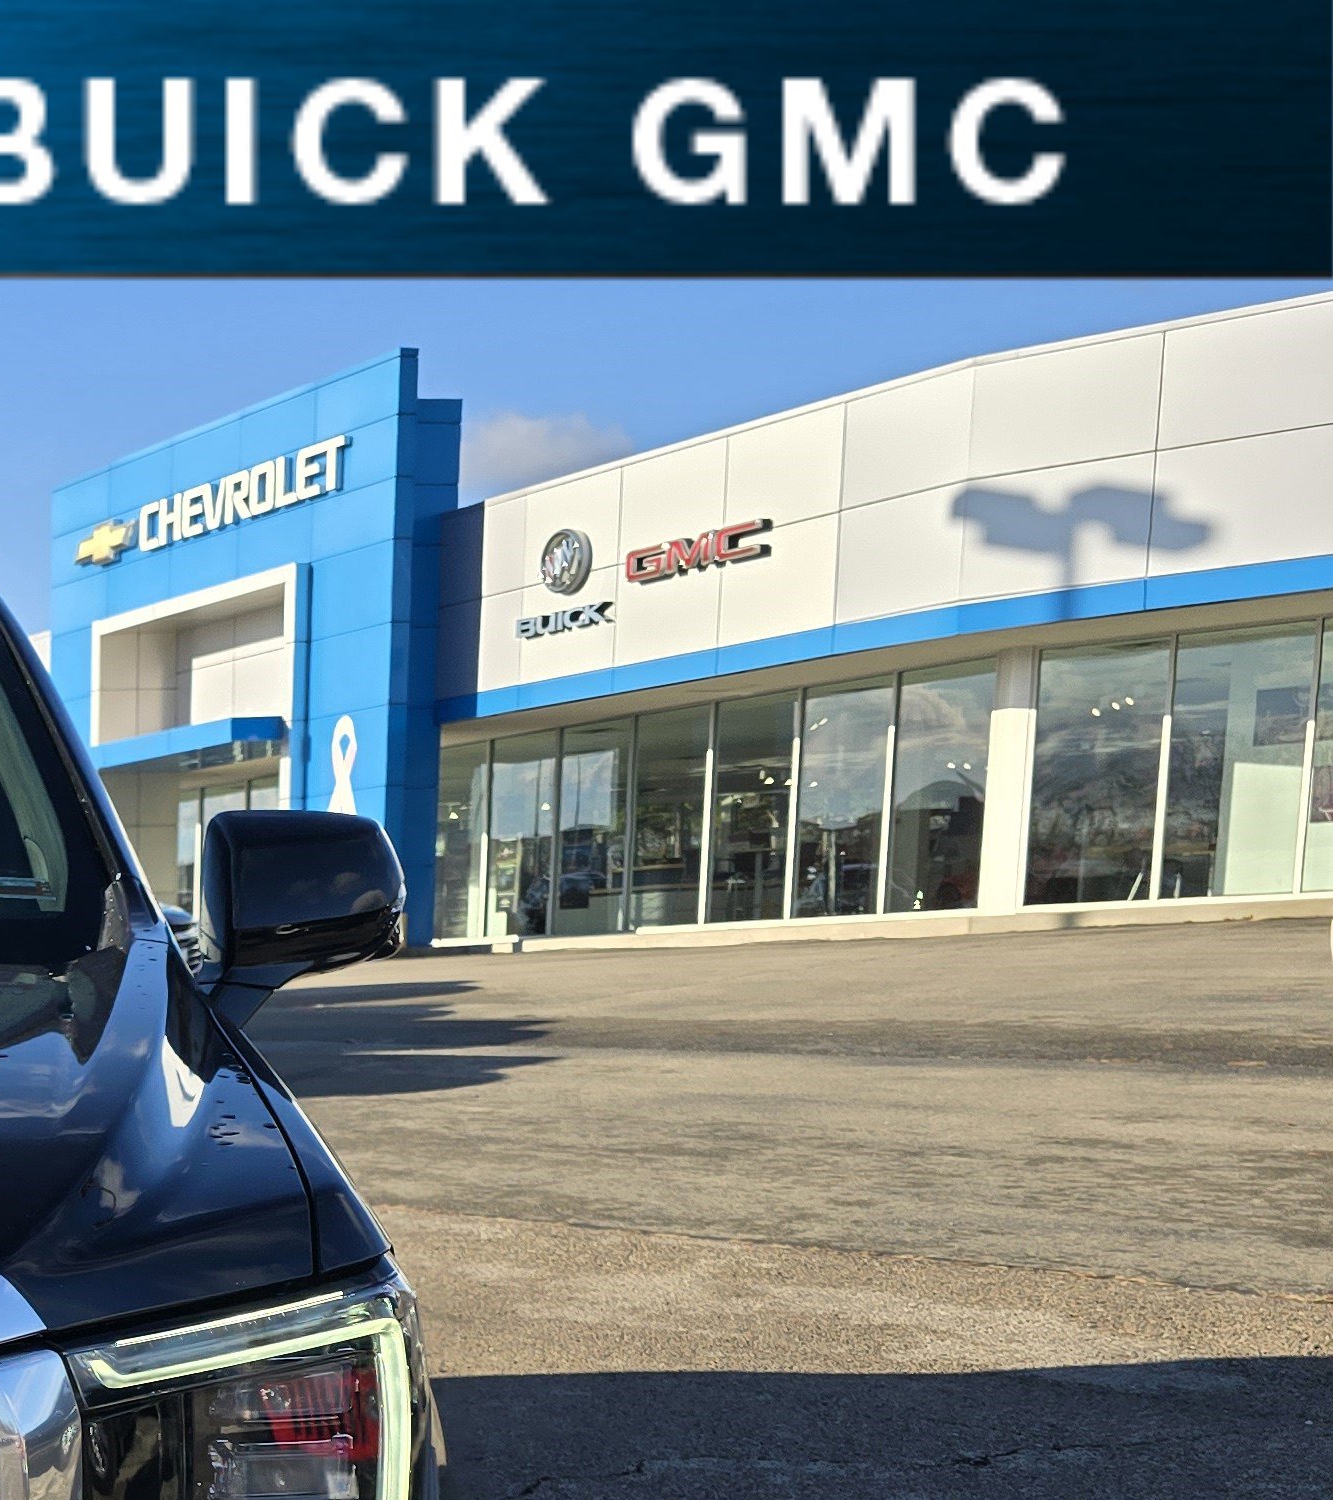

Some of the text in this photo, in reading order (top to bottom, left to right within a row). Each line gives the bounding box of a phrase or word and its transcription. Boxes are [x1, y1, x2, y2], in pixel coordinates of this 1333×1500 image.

[138, 434, 348, 552] CHEVROLET
[624, 518, 772, 586] GMC
[516, 601, 616, 640] BUICK
